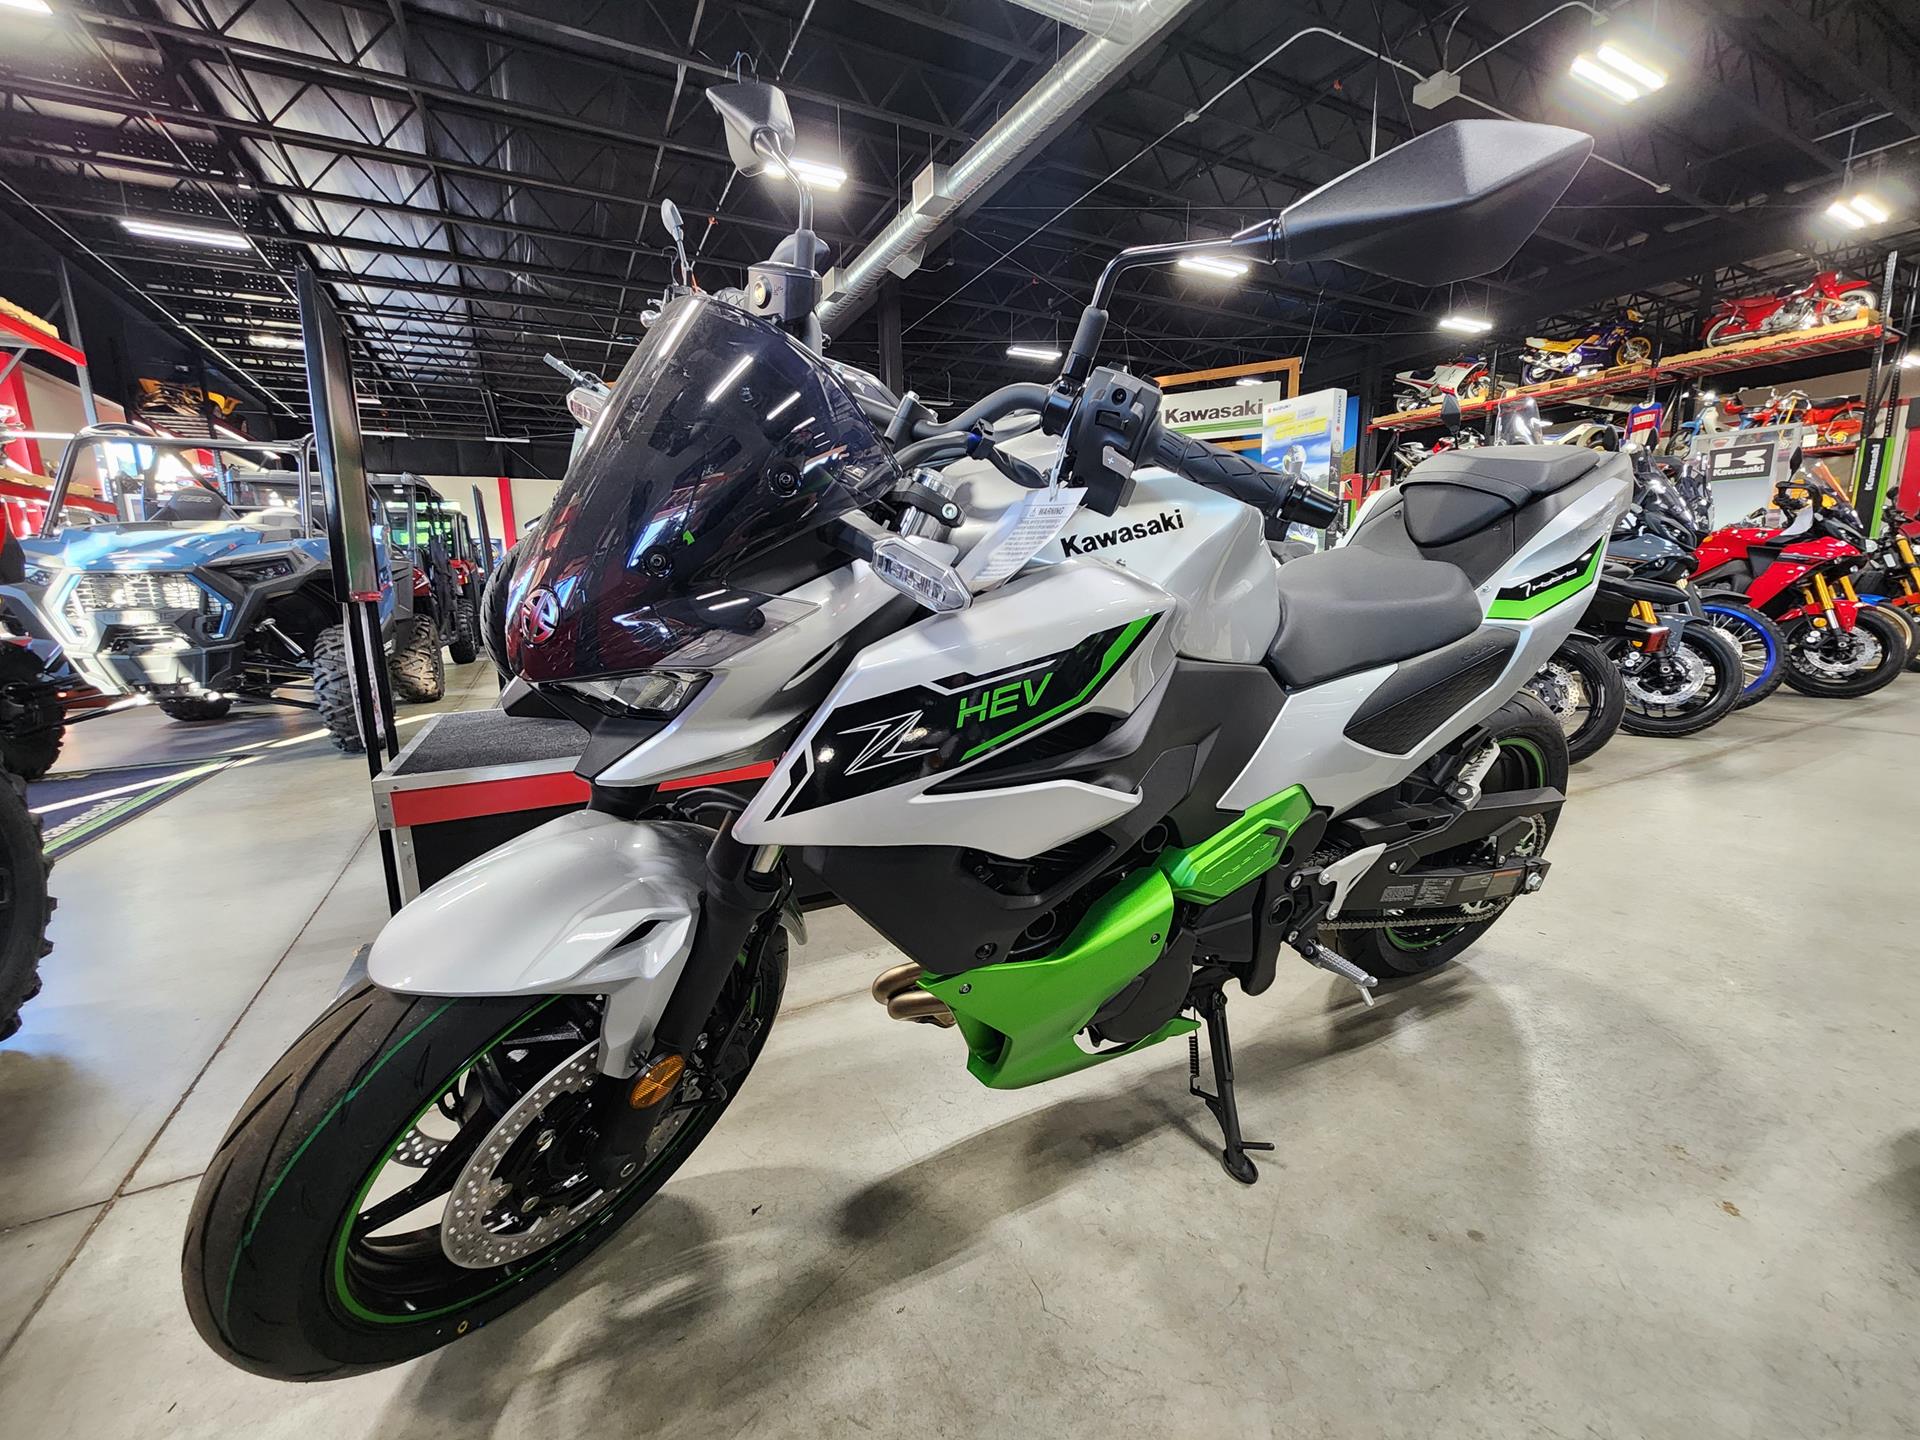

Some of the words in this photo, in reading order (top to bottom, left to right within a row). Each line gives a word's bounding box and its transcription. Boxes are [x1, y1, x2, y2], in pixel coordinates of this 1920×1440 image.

[1164, 399, 1263, 424] Kawasaki
[1713, 464, 1765, 476] Kawasaki
[1864, 443, 1880, 491] Kawasaki
[1060, 509, 1184, 557] Kawasaki
[1520, 583, 1531, 597] 7
[956, 672, 1053, 728] HEV
